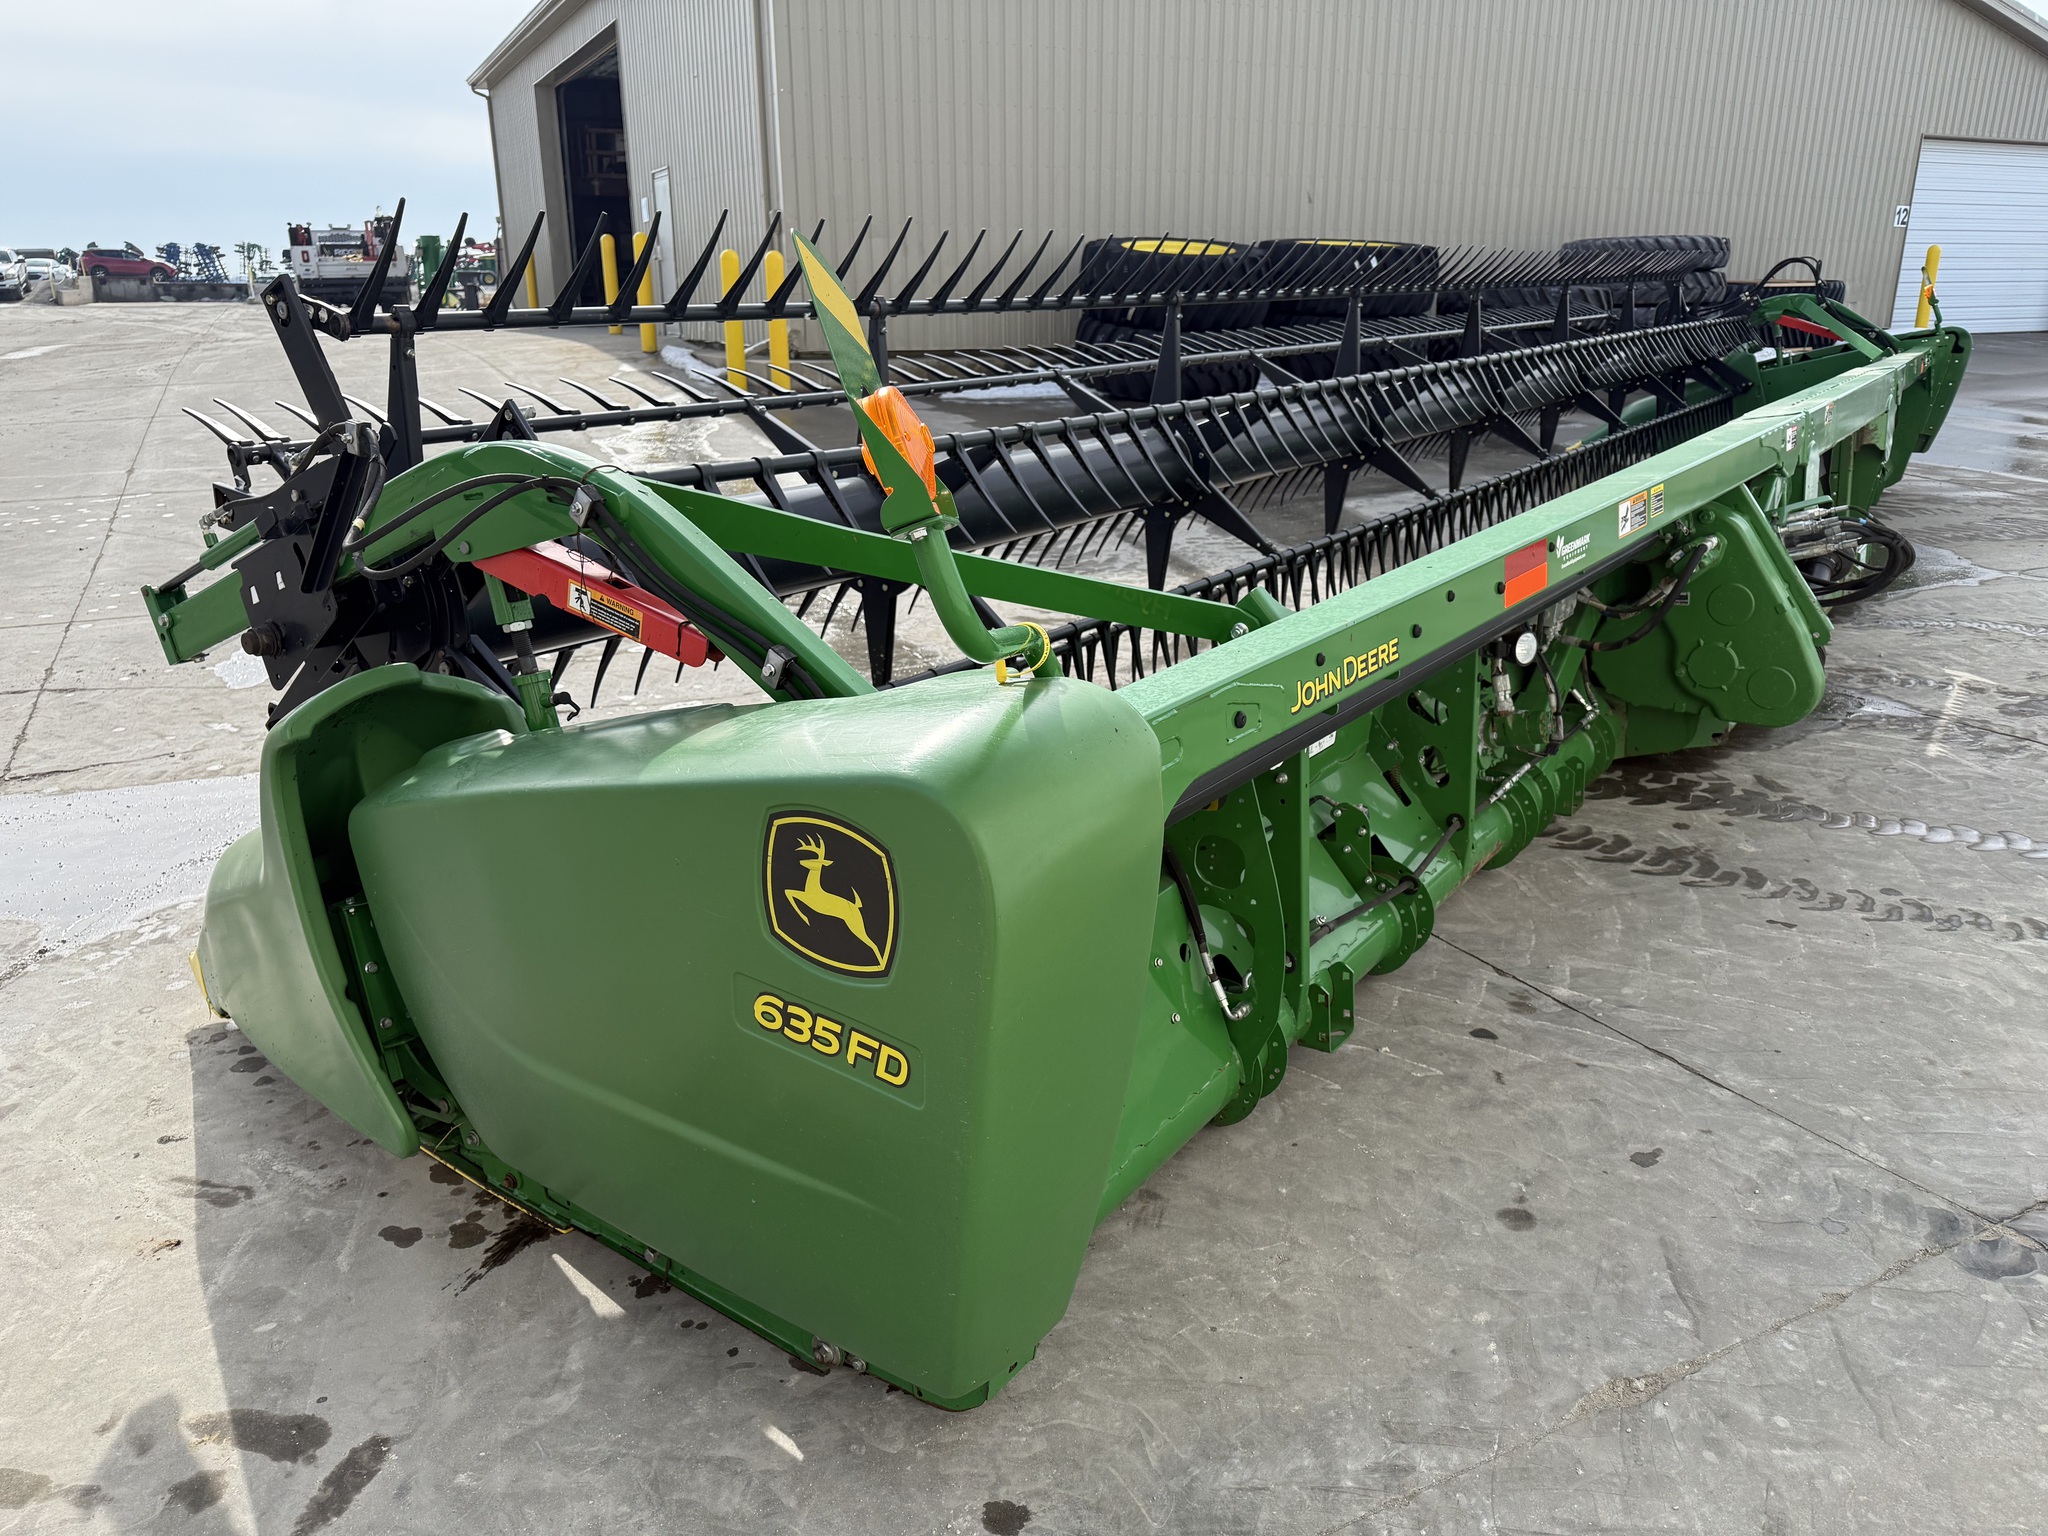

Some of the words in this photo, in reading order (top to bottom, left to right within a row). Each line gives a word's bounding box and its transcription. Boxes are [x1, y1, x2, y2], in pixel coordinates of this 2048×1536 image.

[1896, 207, 1909, 226] 12
[606, 598, 634, 616] WARNING
[1290, 666, 1342, 715] JOHN
[1343, 637, 1400, 687] DEERE
